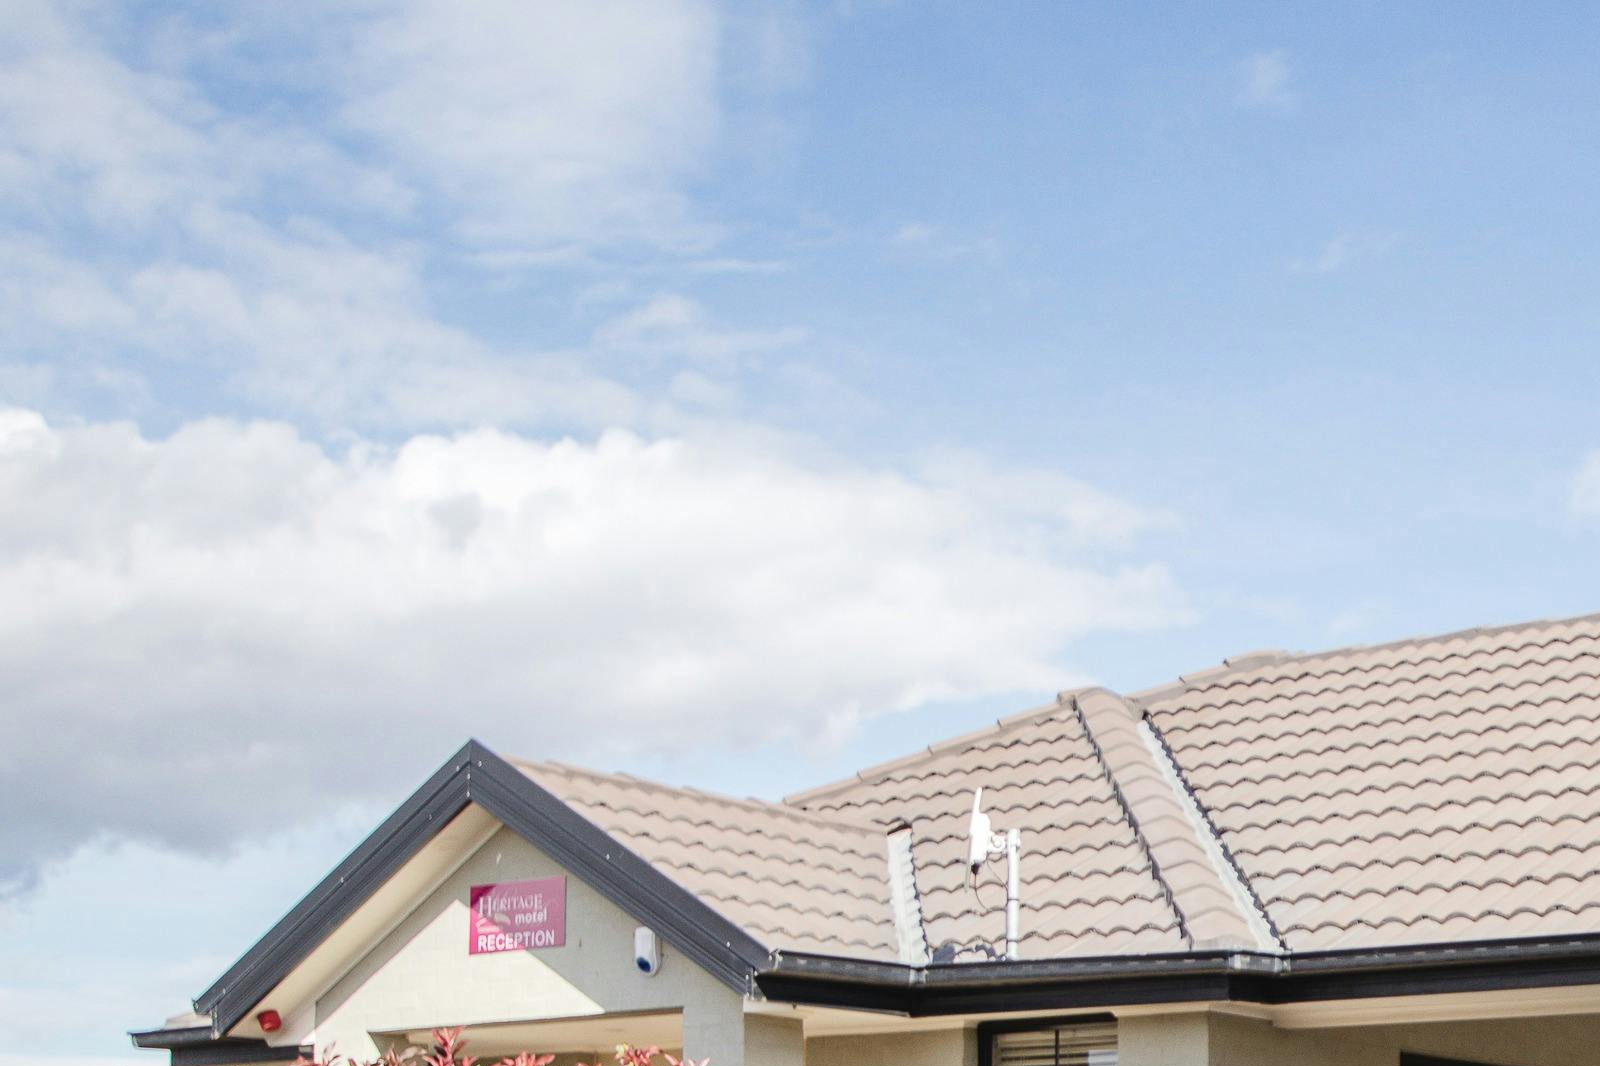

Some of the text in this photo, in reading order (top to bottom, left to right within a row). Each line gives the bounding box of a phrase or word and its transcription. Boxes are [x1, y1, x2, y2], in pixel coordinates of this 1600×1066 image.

[479, 893, 543, 916] HERITAGE
[515, 907, 547, 925] motel
[478, 929, 555, 951] RECEPTION
